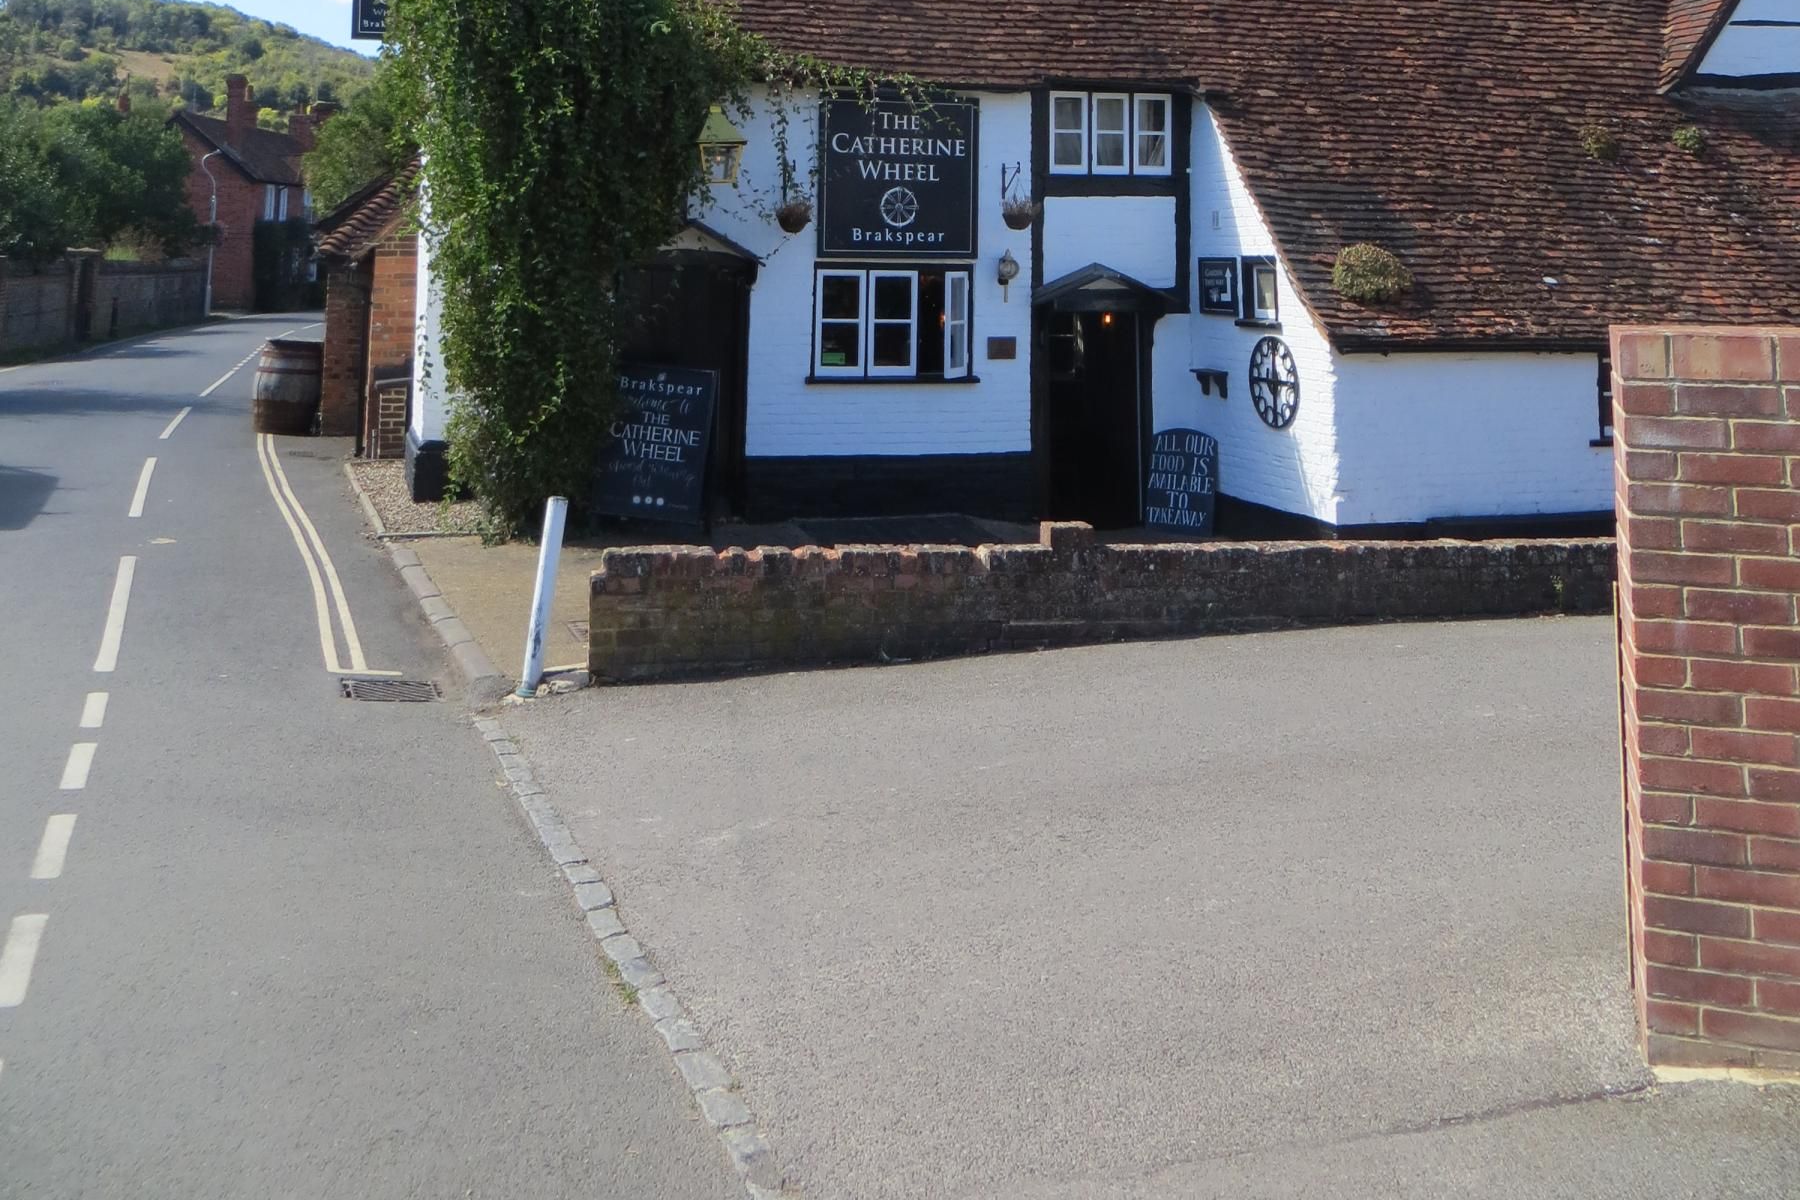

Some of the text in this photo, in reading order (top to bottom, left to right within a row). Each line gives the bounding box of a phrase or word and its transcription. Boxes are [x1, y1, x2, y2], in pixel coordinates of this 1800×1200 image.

[879, 111, 920, 130] THE
[831, 132, 966, 157] CATHERINE
[858, 159, 940, 181] WHEEL
[852, 227, 945, 245] Brakspear
[620, 375, 702, 396] Brakspear
[642, 411, 671, 426] THE
[609, 421, 702, 446] CATHERINE
[623, 439, 686, 462] WHEEL
[1155, 434, 1214, 456] ALL OUR
[1151, 453, 1210, 477] FOOD IS
[1147, 472, 1214, 495] AVAILABLE
[1166, 491, 1189, 509] TO
[1146, 506, 1207, 527] TAKEAWAY
